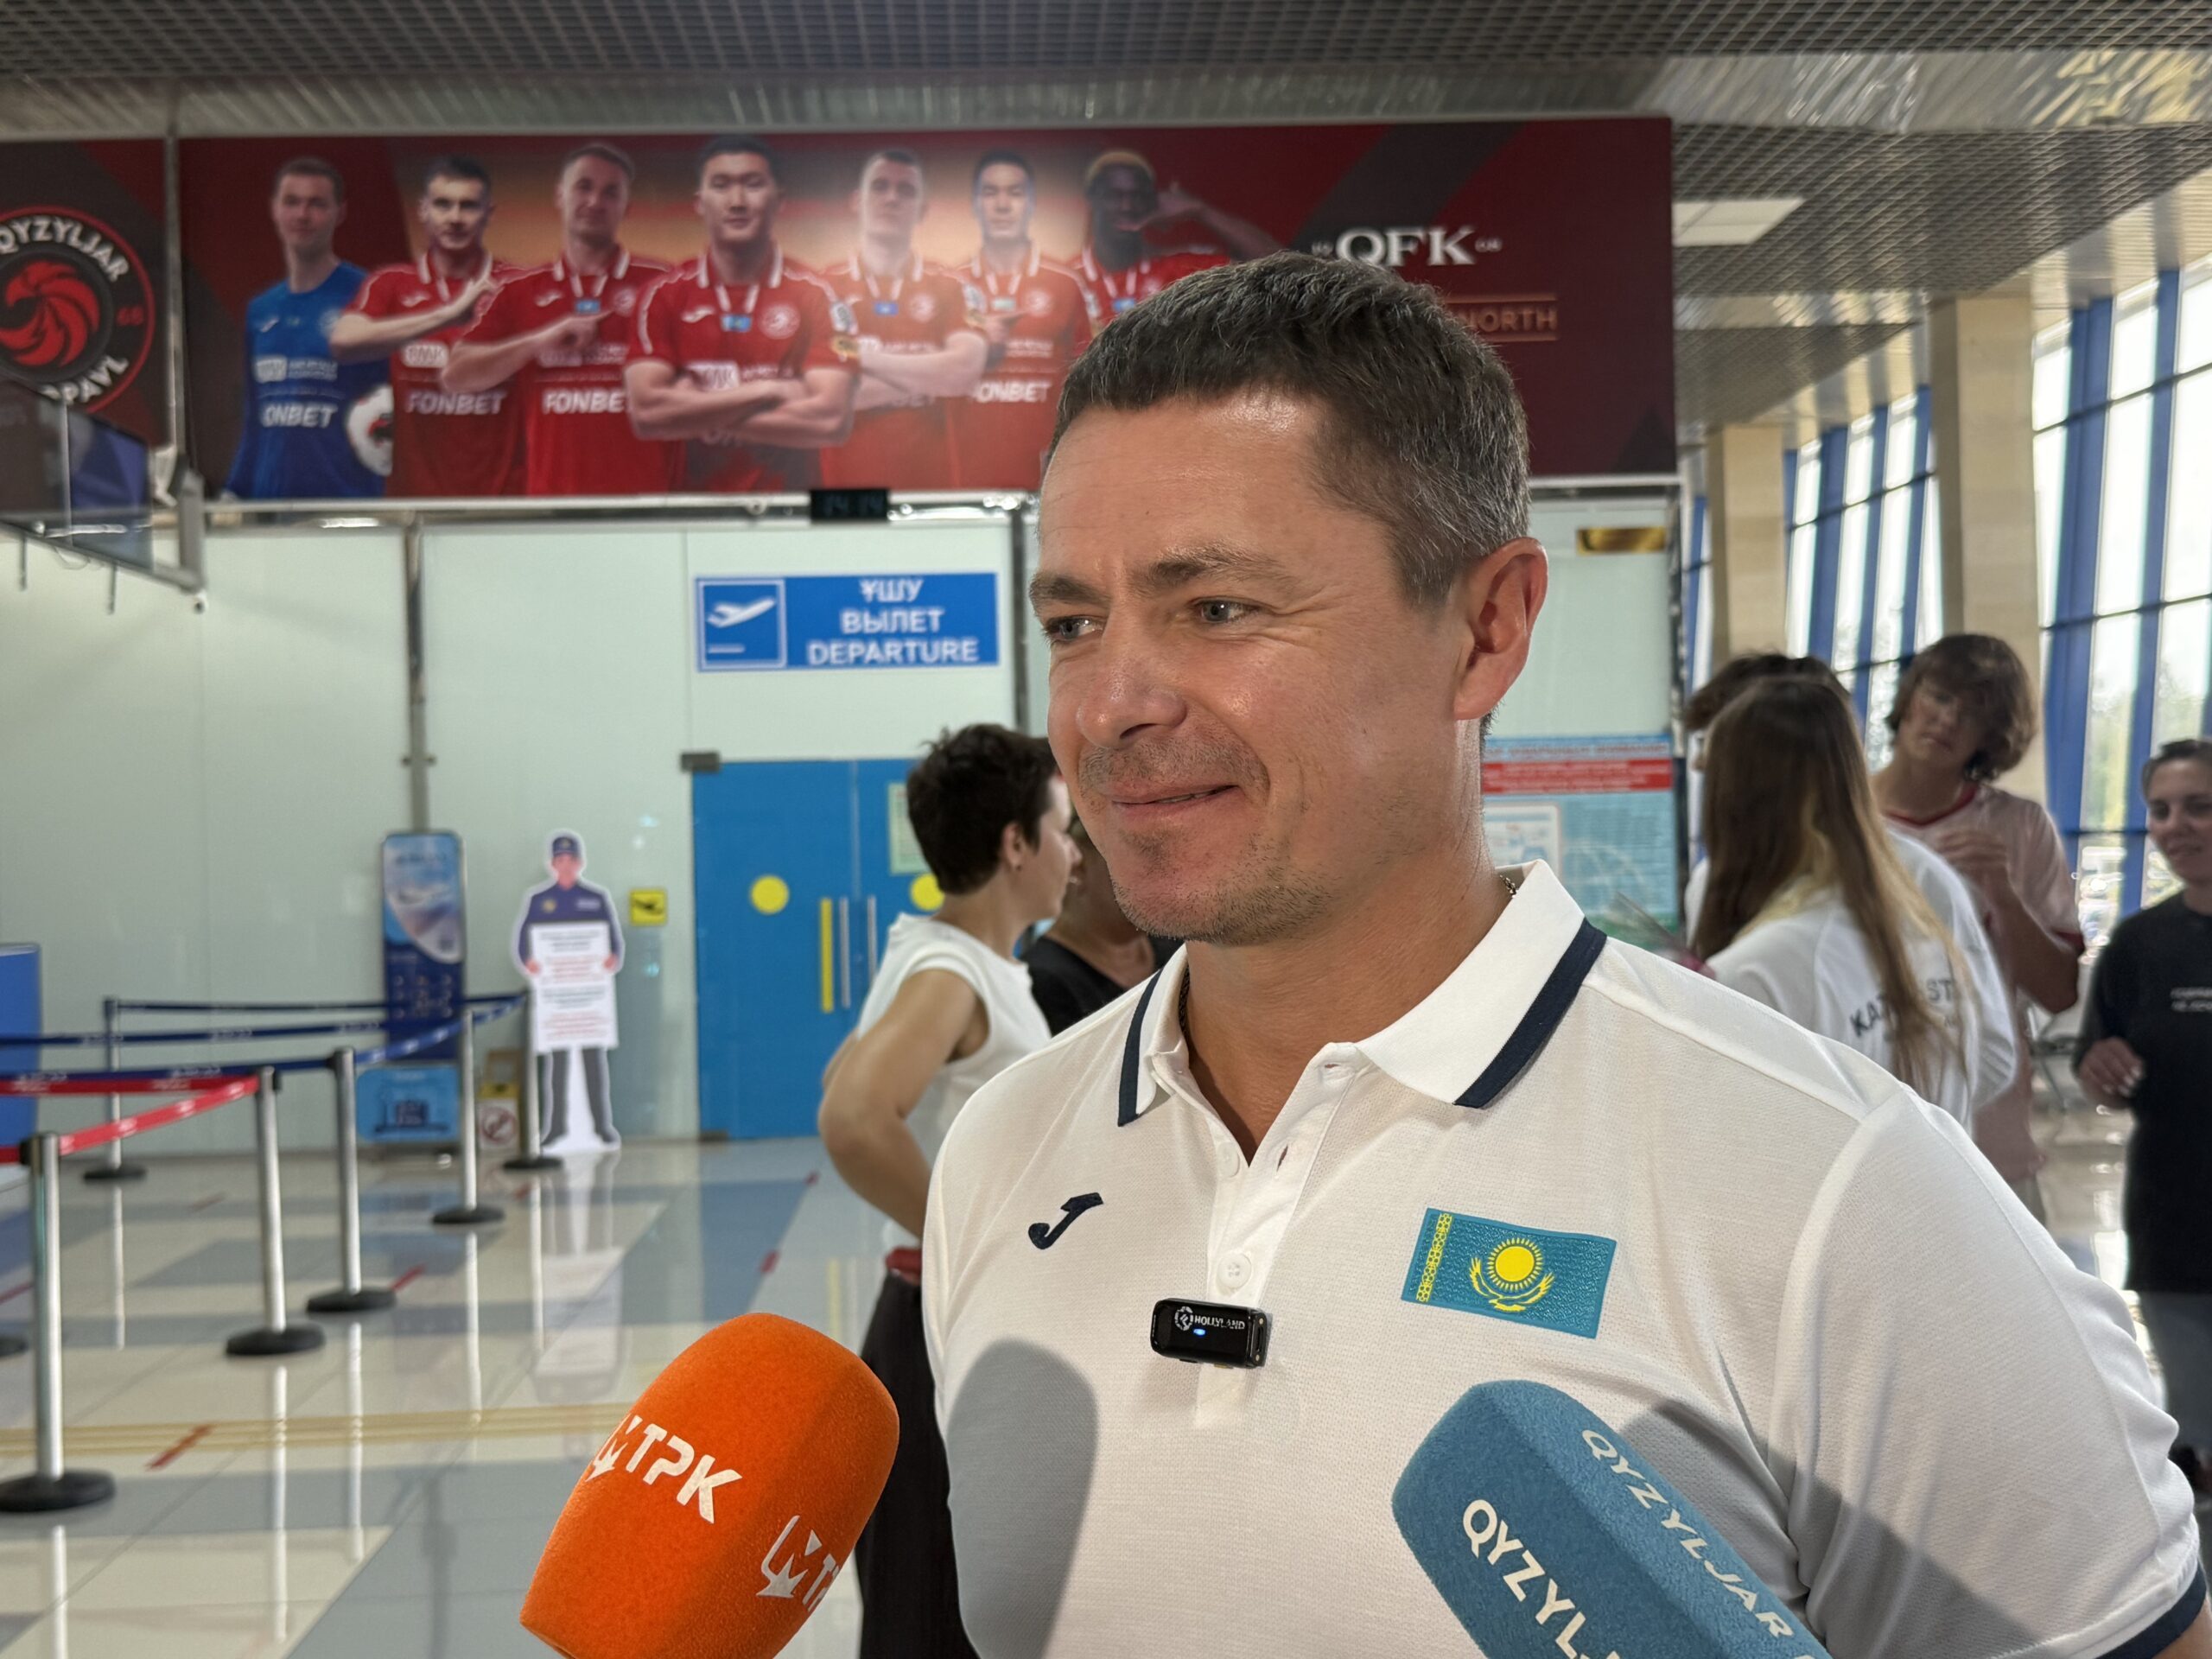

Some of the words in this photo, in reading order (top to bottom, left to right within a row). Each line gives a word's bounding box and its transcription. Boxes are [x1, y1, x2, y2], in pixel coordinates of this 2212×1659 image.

[0, 215, 130, 282] QYZYLJAR
[1336, 226, 1474, 266] QFK
[406, 391, 507, 415] FONBET
[542, 391, 627, 414] FONBE
[972, 381, 1052, 404] ONBET
[841, 608, 944, 635] ВЫЛЕТ
[807, 638, 979, 665] DEPARTURE
[1582, 1429, 1795, 1639] QYZYLJAR
[1463, 1499, 1621, 1659] QYZYL
